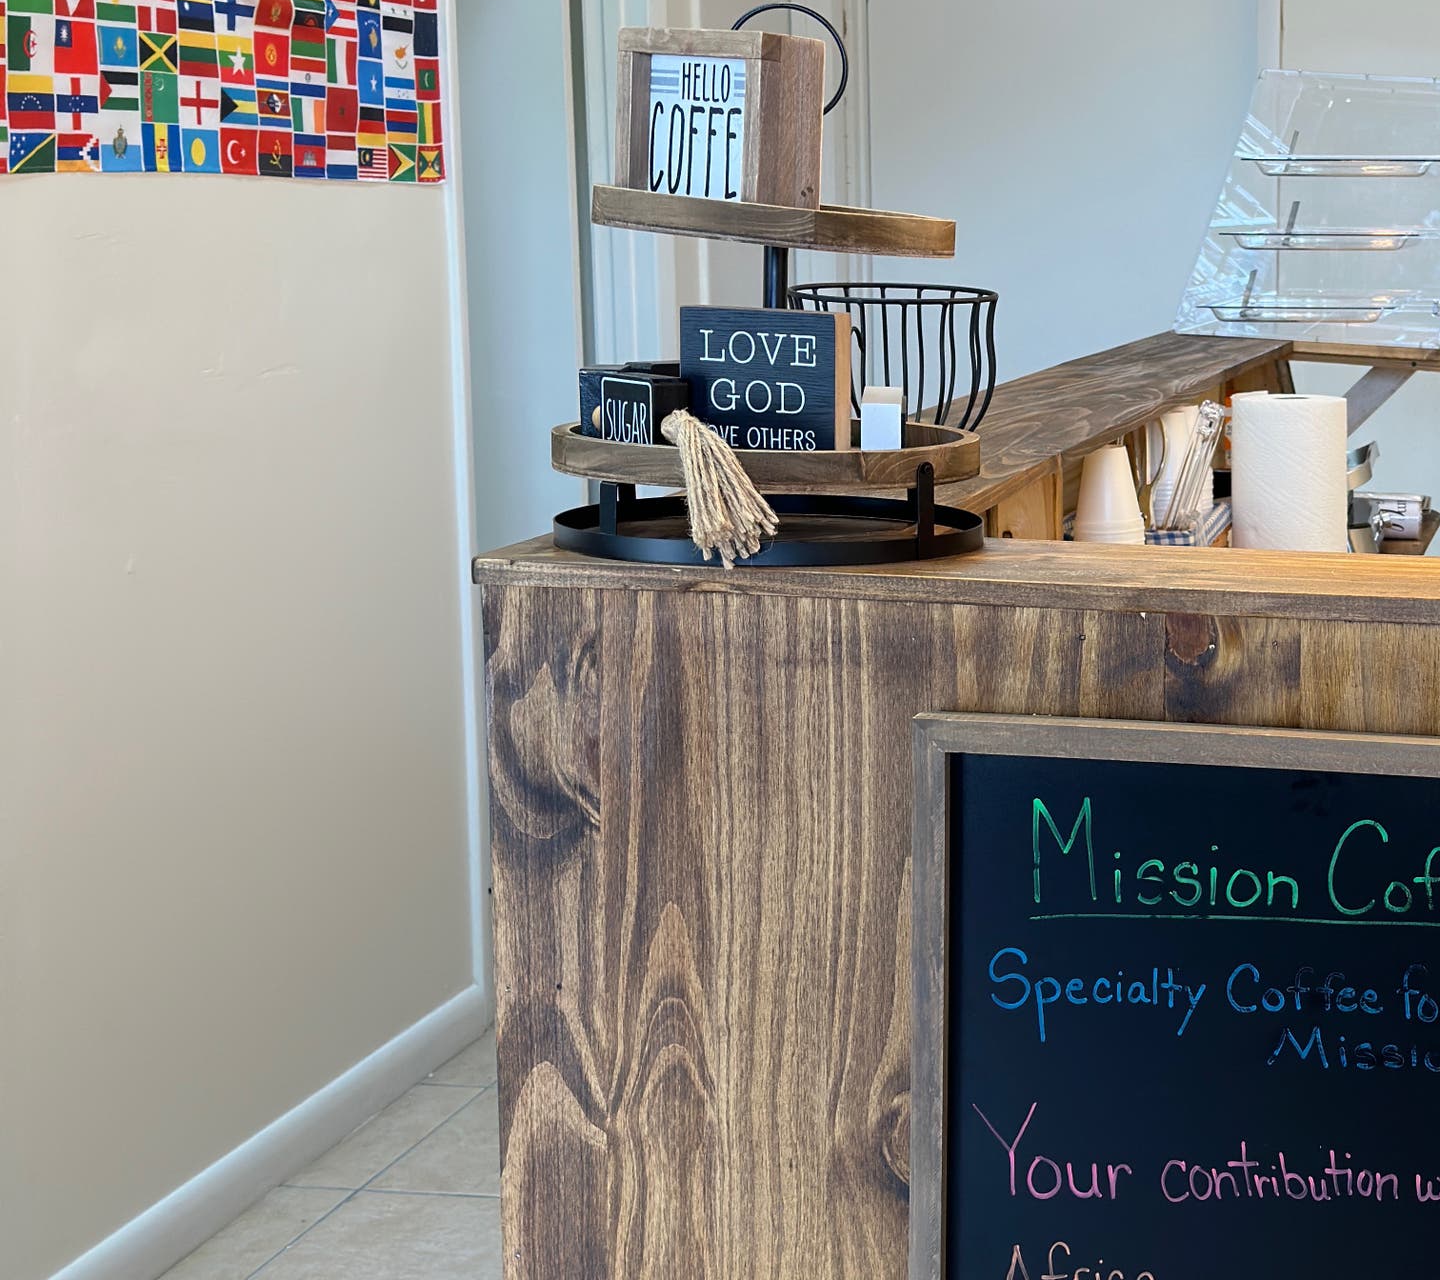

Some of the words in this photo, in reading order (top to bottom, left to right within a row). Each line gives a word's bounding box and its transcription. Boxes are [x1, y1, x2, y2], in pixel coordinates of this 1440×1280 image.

[681, 62, 732, 103] HELLO
[699, 329, 817, 368] LOVE
[710, 377, 806, 415] GOD
[606, 397, 649, 444] SUGAR
[747, 426, 817, 451] OTHERS
[1033, 796, 1300, 910] Mission
[987, 946, 1207, 1042] Specialty
[1226, 962, 1384, 1015] Coffee
[972, 1102, 1133, 1202] Your
[1161, 1140, 1400, 1204] contribution
